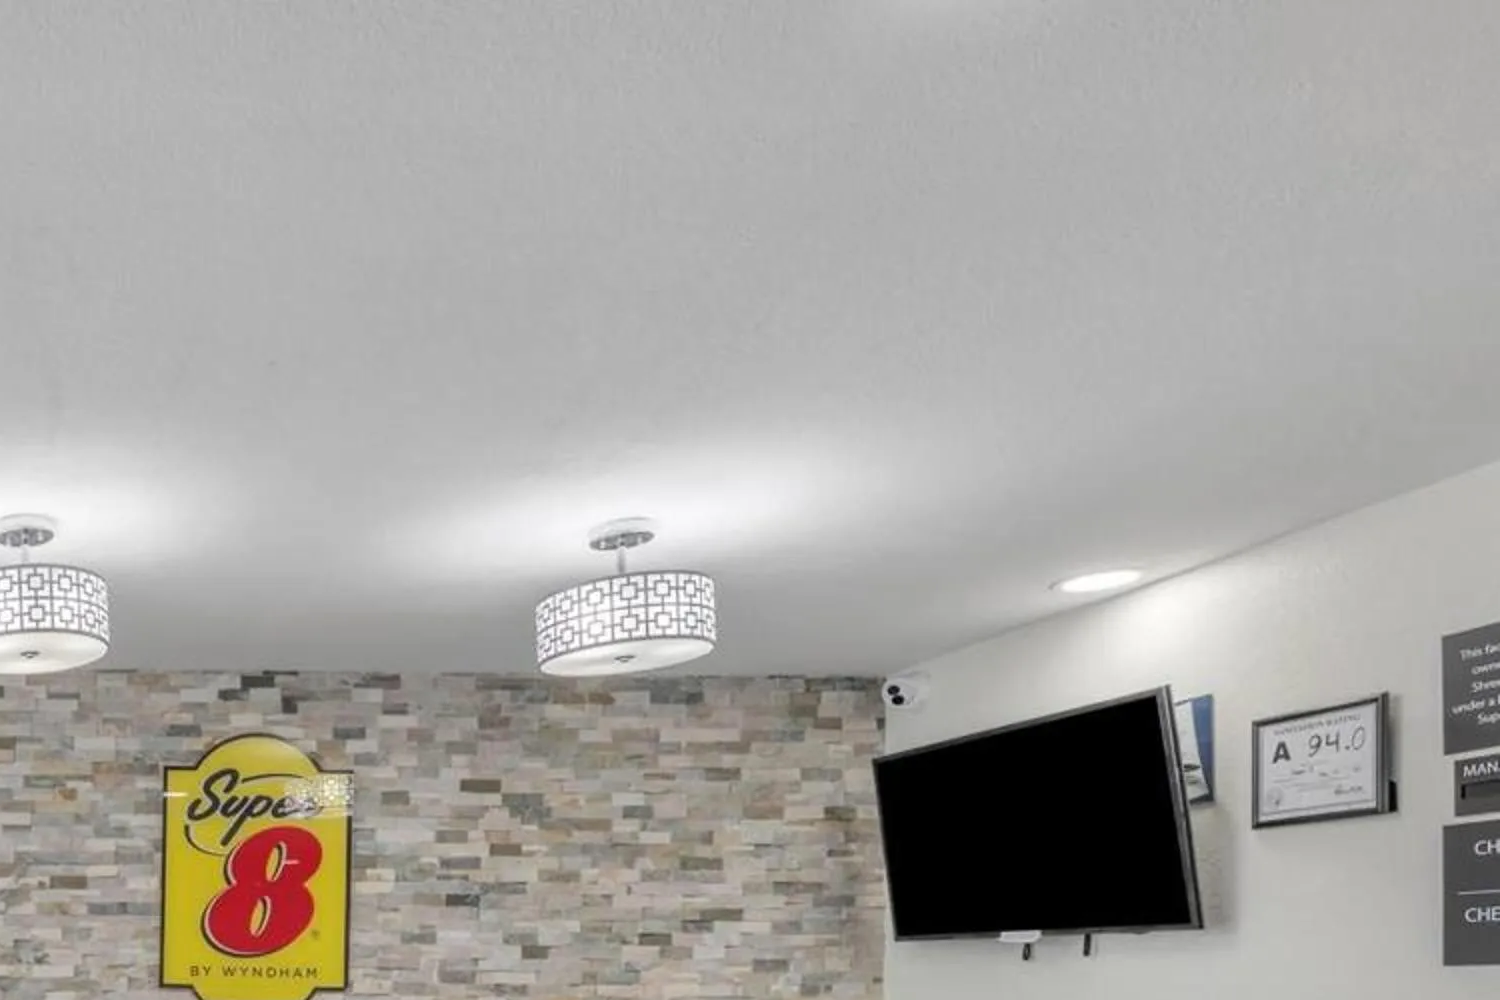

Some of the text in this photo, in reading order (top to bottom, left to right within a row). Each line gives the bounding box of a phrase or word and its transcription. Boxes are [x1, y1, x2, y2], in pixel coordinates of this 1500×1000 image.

[1272, 726, 1365, 764] A 94.0
[201, 825, 323, 957] 8
[189, 965, 319, 979] BY WYNDHAM
